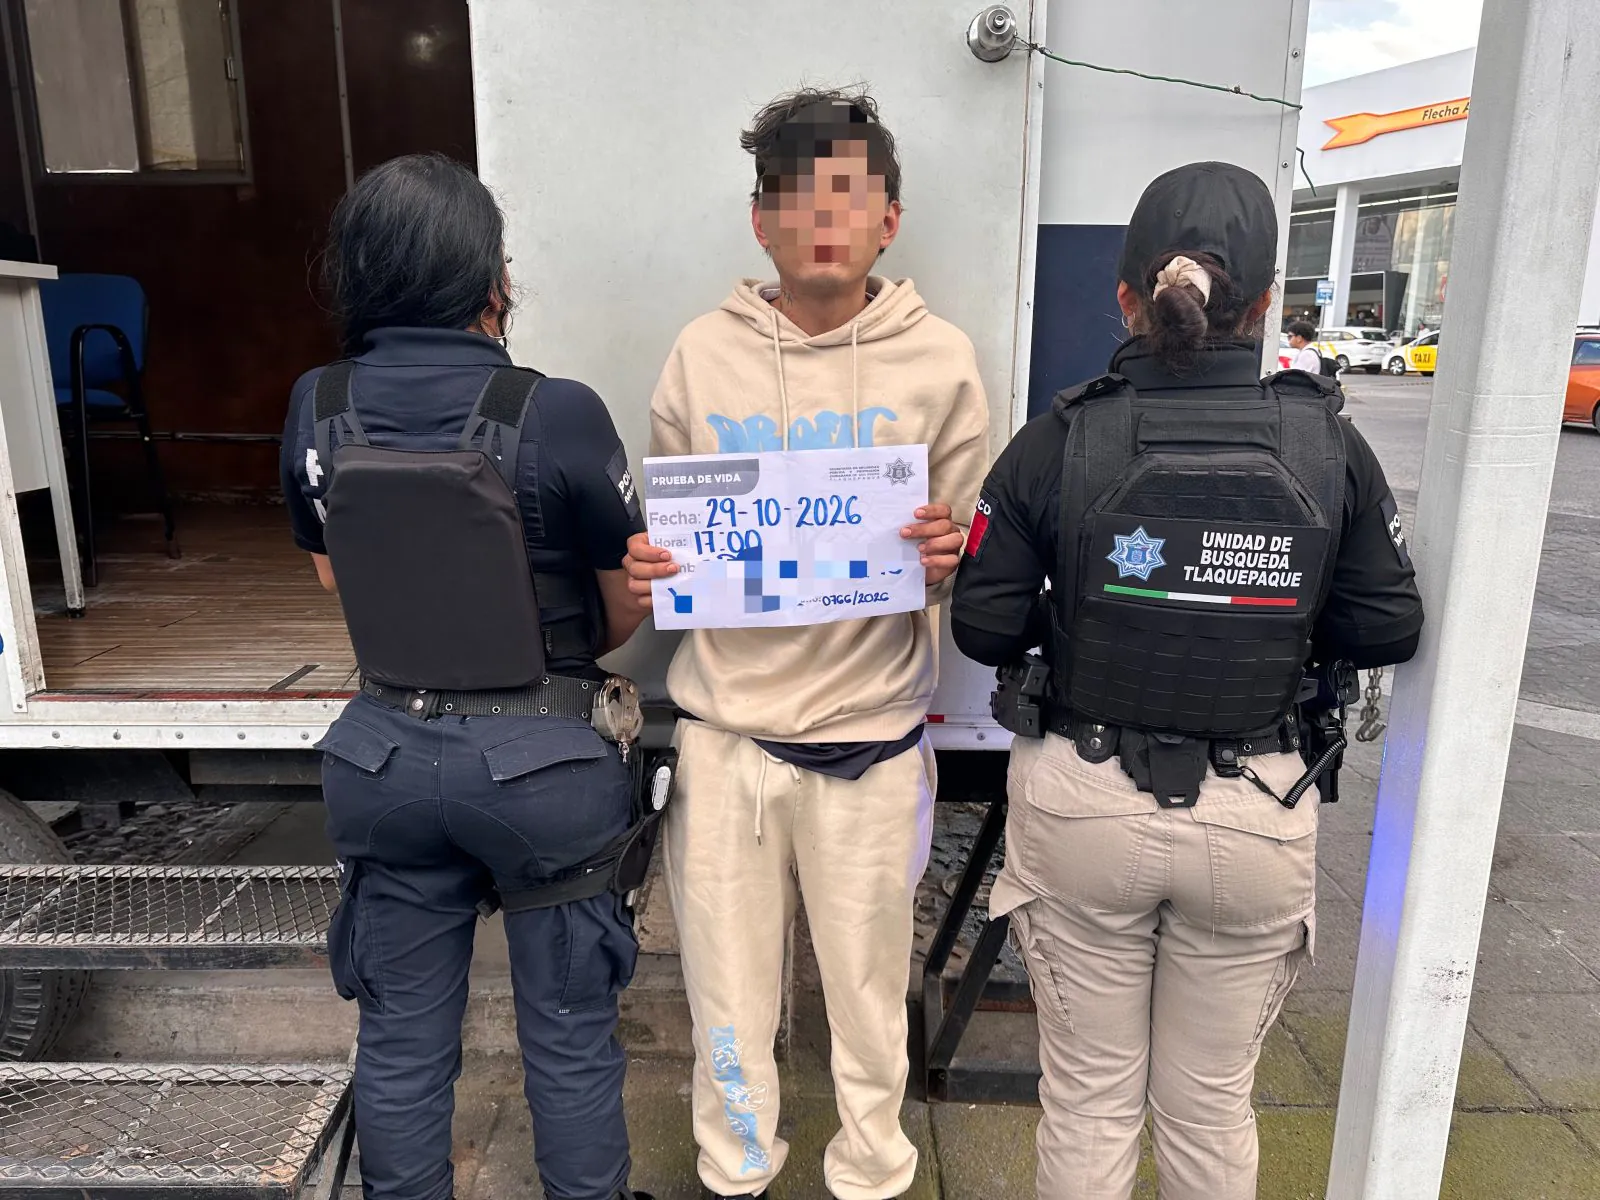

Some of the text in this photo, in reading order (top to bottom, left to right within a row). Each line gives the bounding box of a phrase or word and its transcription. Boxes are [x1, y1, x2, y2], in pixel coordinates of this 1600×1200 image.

[1422, 105, 1460, 121] Flecha
[1414, 353, 1431, 363] TAXI
[652, 473, 741, 486] PRUEBA DE VIDA
[649, 510, 702, 527] Fecha:
[654, 536, 687, 549] Hora:
[1201, 530, 1294, 553] UNIDAD DE
[1199, 549, 1290, 570] BUSQUEDA
[1183, 565, 1303, 588] TLAQUEPAQUE
